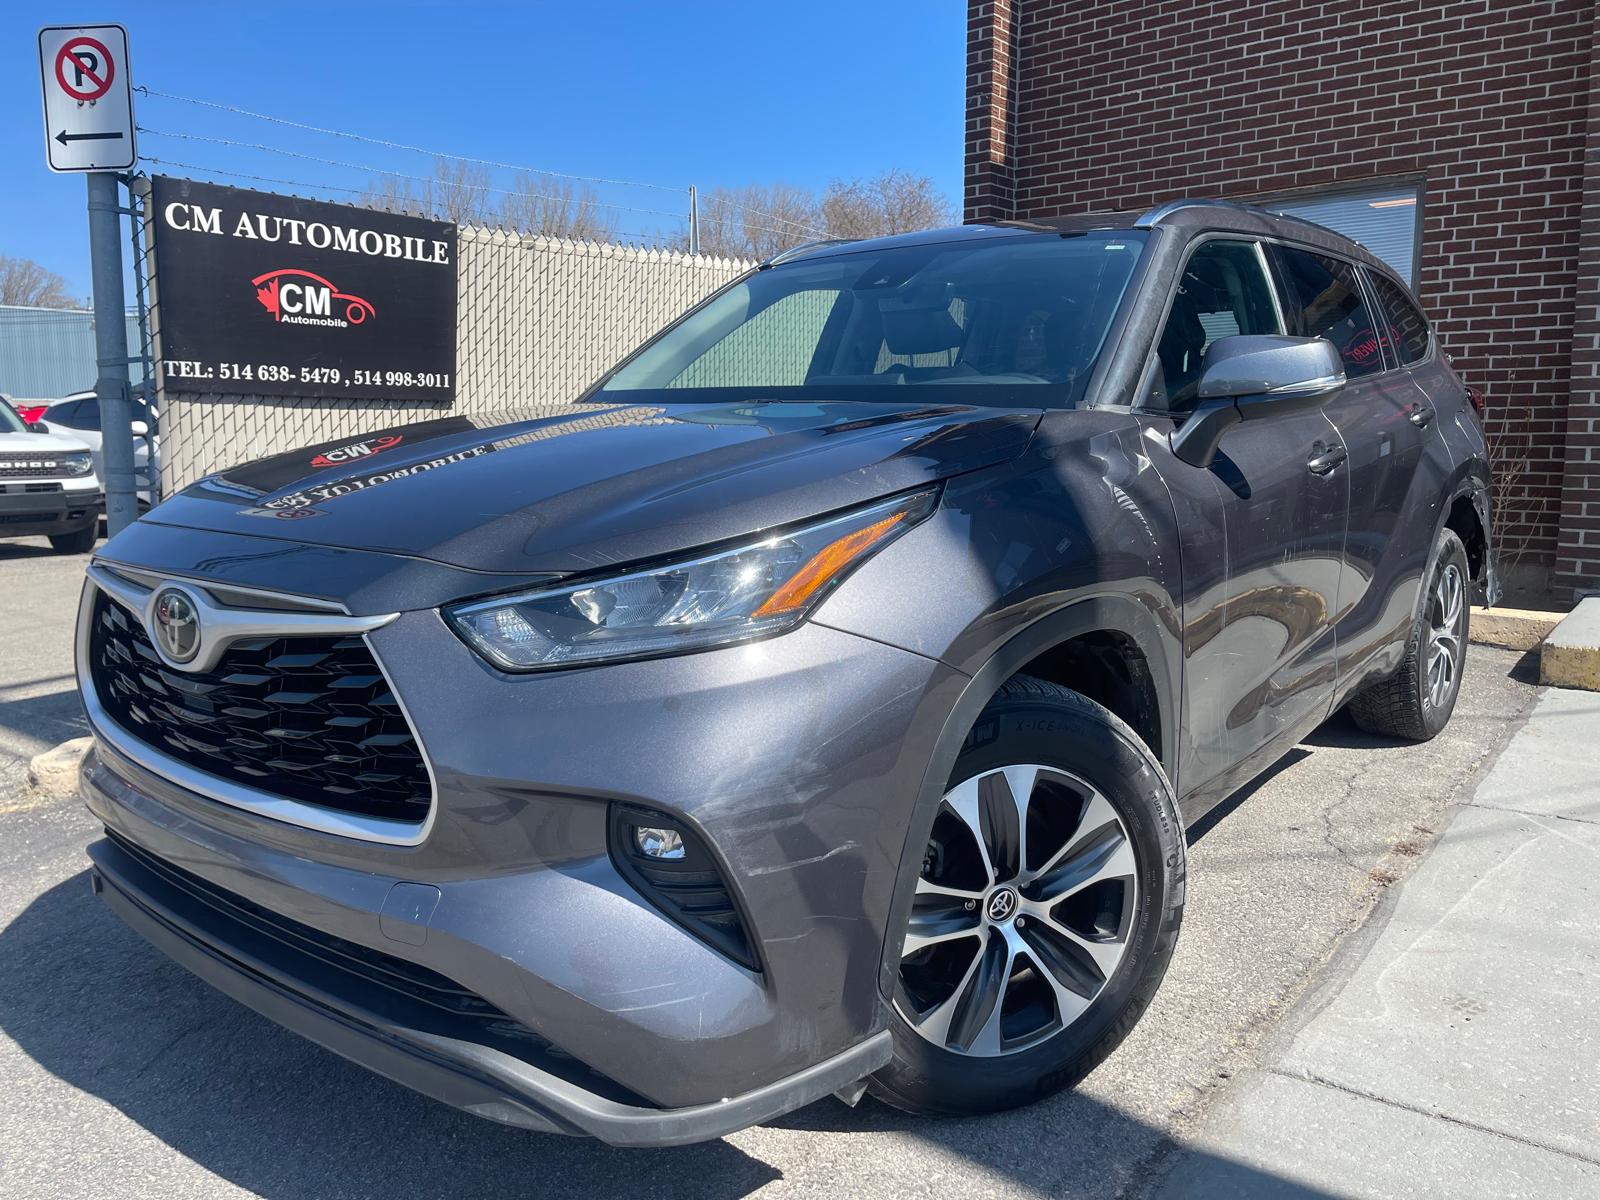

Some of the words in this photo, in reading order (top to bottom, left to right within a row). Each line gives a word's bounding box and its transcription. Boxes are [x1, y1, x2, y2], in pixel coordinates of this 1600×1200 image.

[164, 202, 224, 235] CM
[233, 212, 449, 264] AUTOMOBILE
[280, 283, 331, 316] CM
[281, 315, 347, 328] Automobile
[163, 360, 214, 379] TEL:
[219, 363, 253, 380] 514
[258, 365, 296, 382] 638-
[300, 367, 341, 384] 5479
[353, 370, 382, 386] 514
[385, 371, 450, 388] 998-3011
